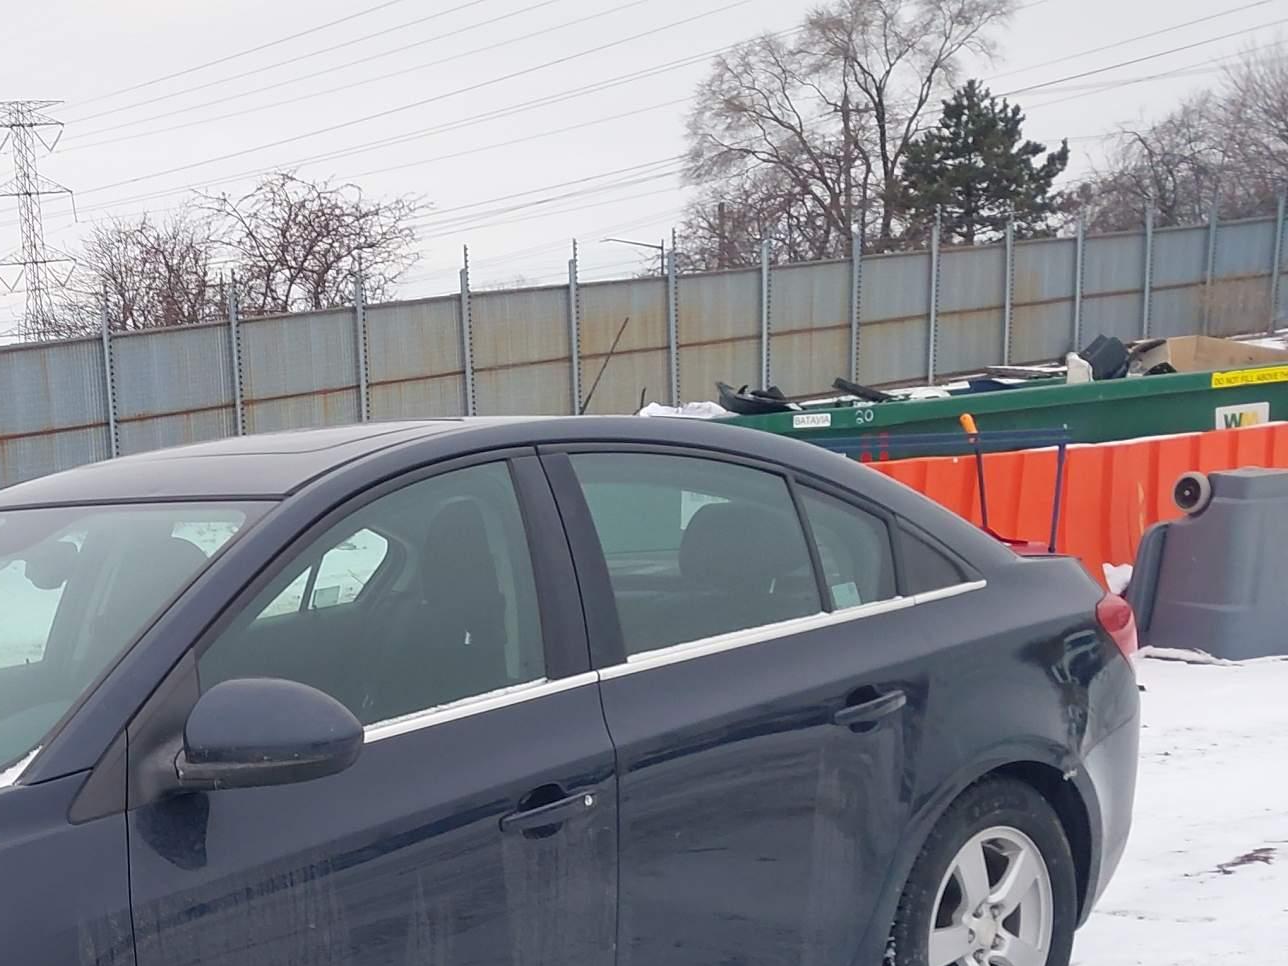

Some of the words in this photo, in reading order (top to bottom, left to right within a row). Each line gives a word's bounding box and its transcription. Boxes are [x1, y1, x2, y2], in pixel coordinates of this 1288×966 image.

[1226, 376, 1239, 384] NOT
[1241, 375, 1254, 383] FILL
[1256, 372, 1278, 380] ABOVE
[794, 415, 830, 426] BATAVIA
